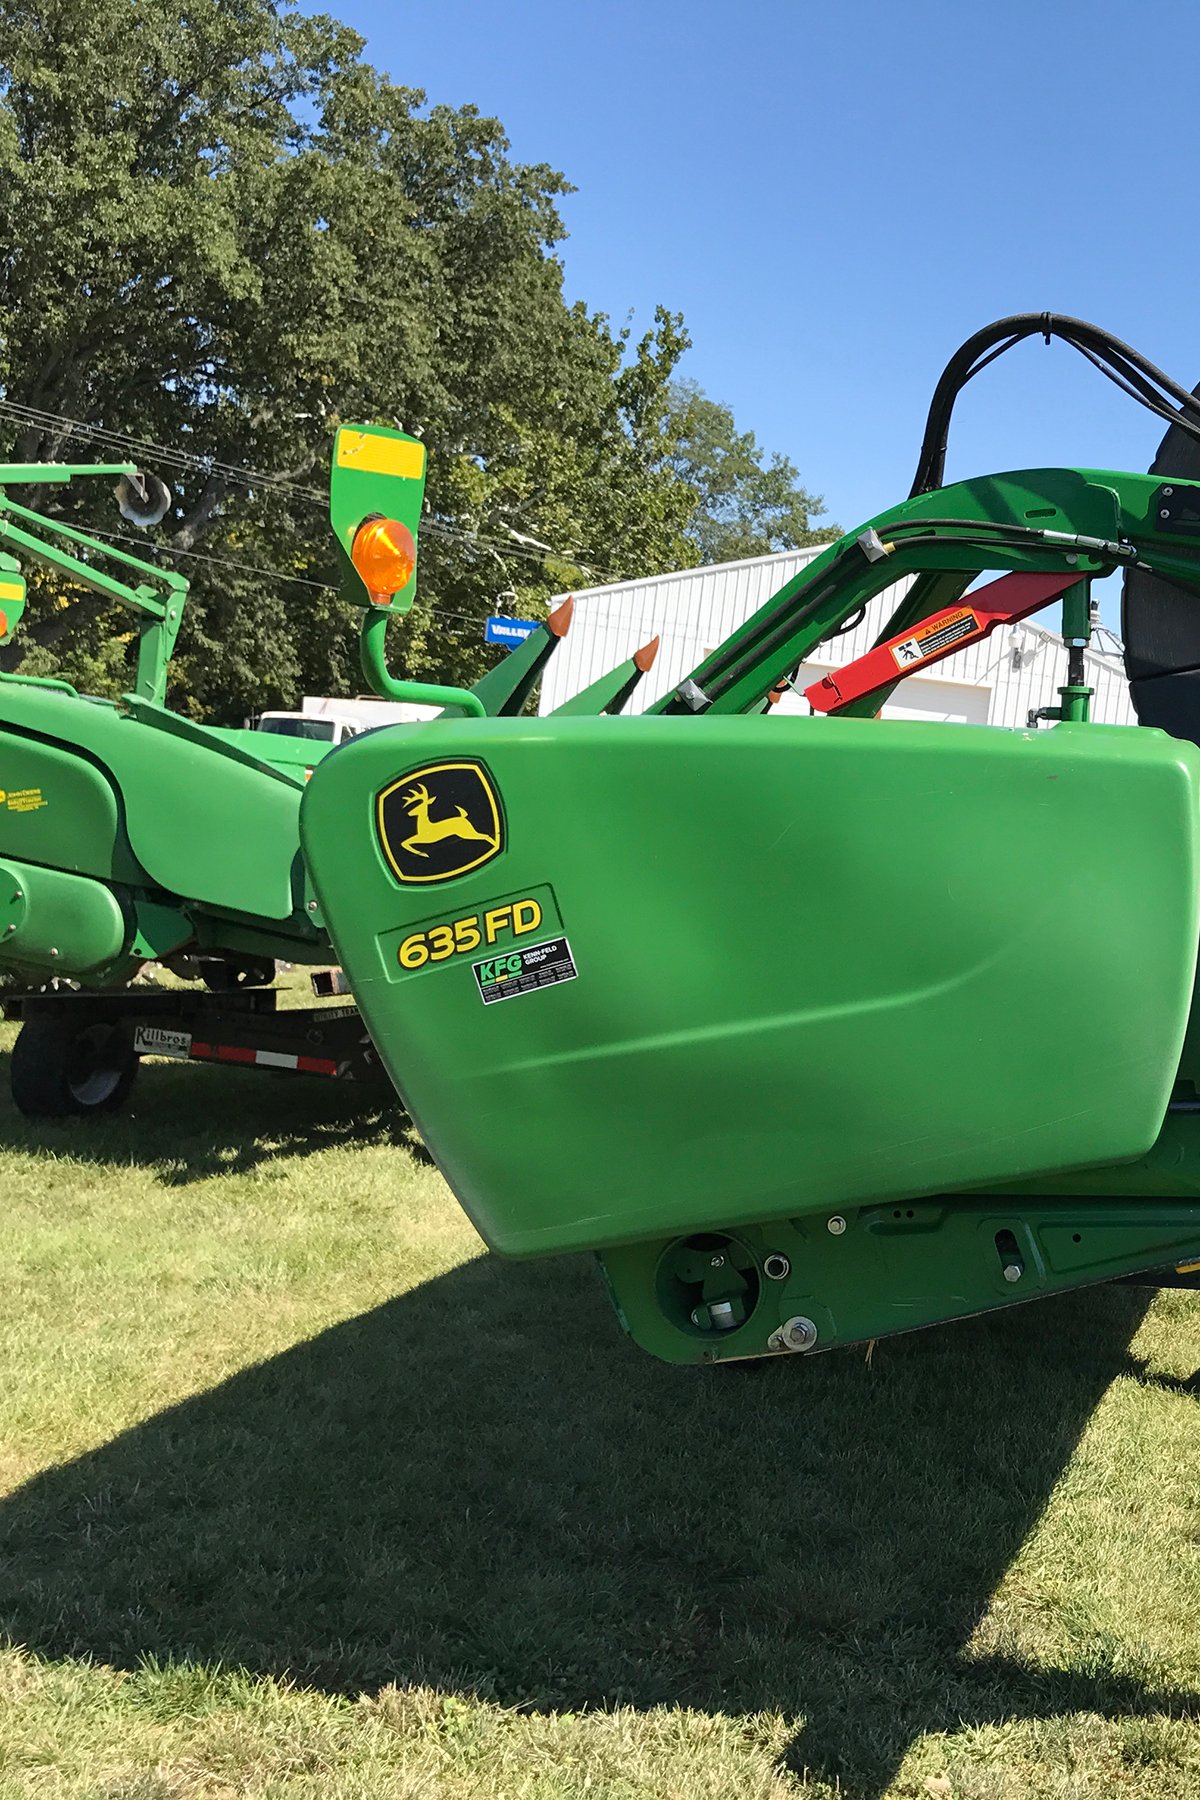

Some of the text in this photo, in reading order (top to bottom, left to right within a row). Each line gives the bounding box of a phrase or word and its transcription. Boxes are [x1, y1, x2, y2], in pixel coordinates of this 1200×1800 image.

[932, 611, 964, 630] WARNING
[398, 898, 542, 969] 635FD
[522, 945, 558, 960] KENN-FELD
[524, 954, 548, 966] GROUP
[481, 954, 522, 982] KFG
[135, 1027, 187, 1046] Killbros
